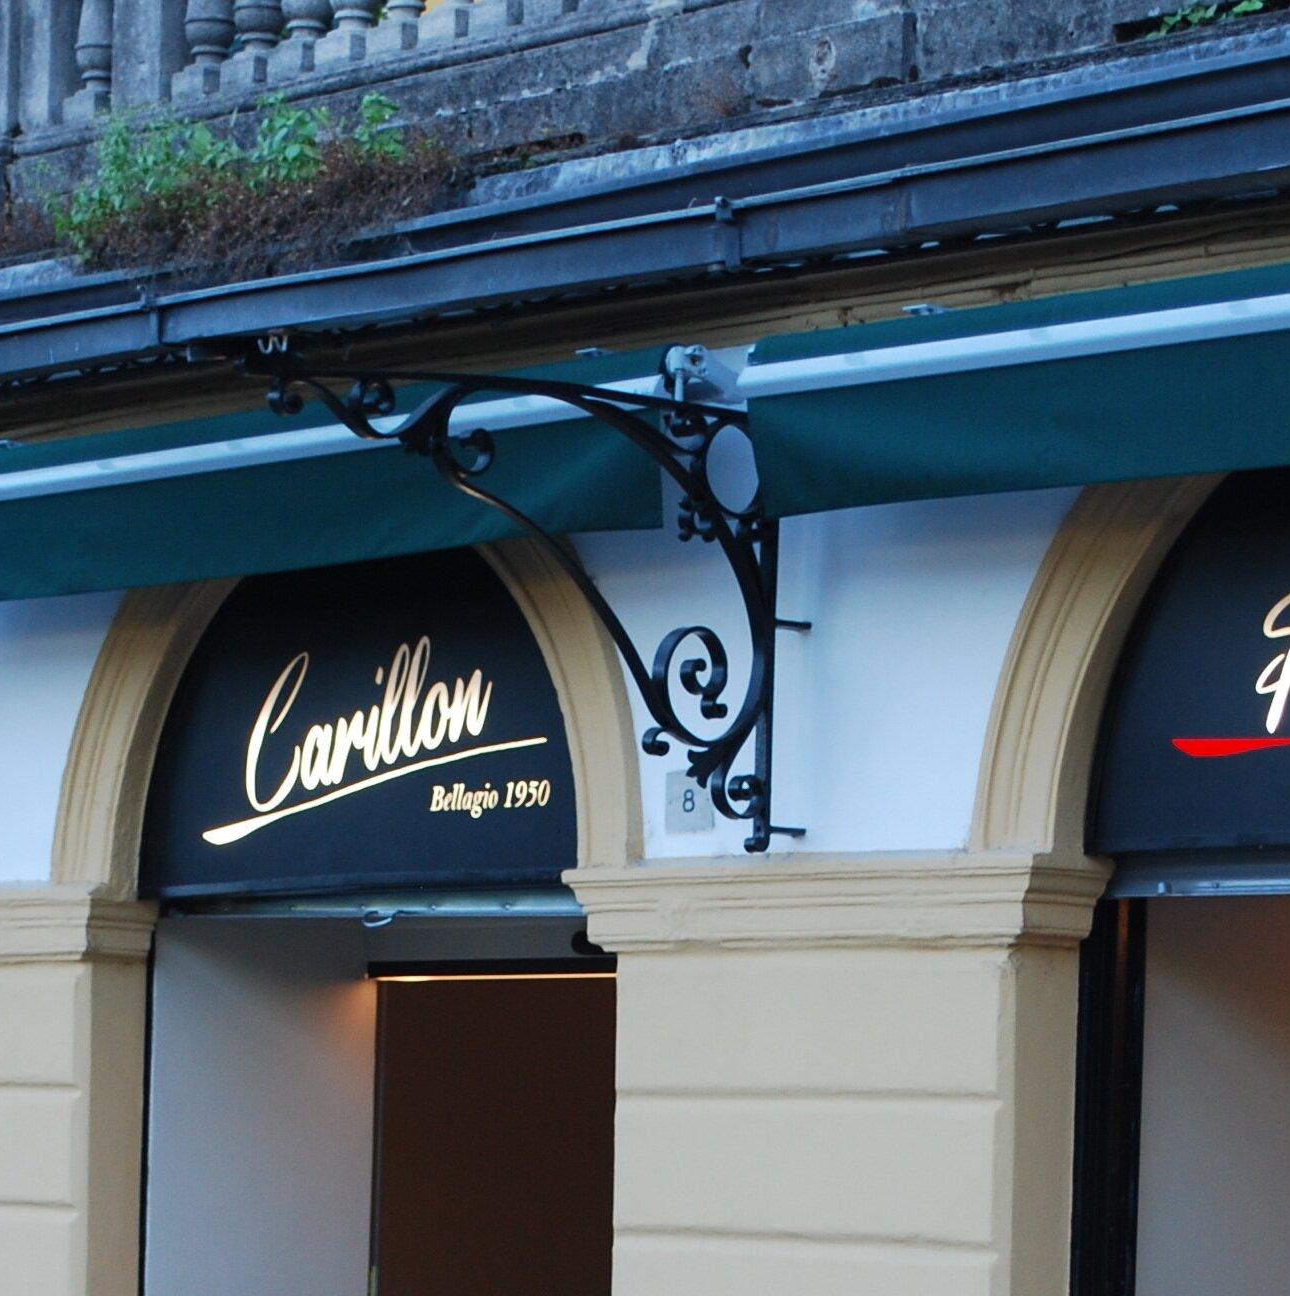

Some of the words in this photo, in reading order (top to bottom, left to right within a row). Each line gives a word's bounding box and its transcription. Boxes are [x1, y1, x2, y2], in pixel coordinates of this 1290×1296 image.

[245, 635, 493, 813] Carillon
[429, 782, 499, 820] Bellagio
[504, 779, 552, 809] 1950
[682, 788, 695, 813] 8
